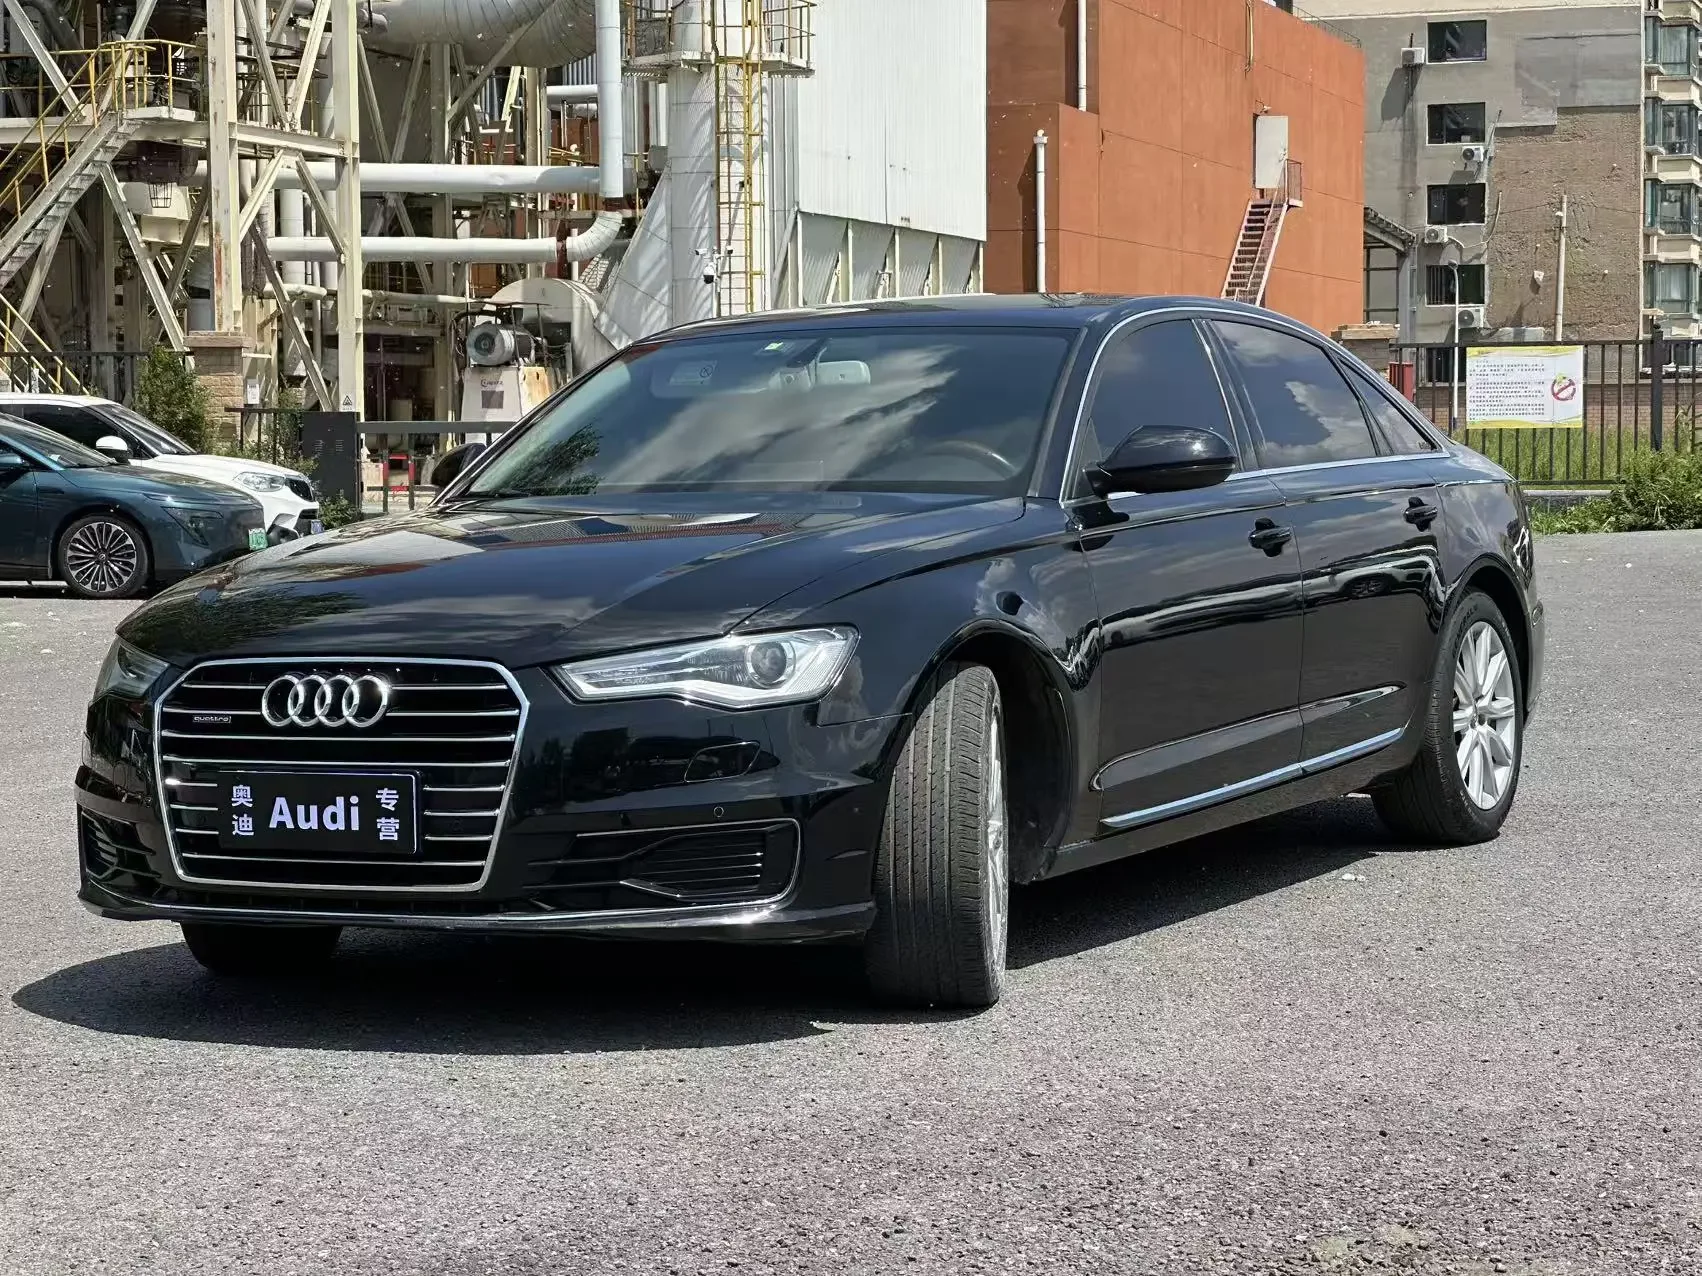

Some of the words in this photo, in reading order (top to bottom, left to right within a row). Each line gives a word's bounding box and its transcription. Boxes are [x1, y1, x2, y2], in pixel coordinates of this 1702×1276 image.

[231, 784, 254, 836] 奥迪
[269, 796, 360, 831] Audi
[375, 787, 400, 841] 专营
